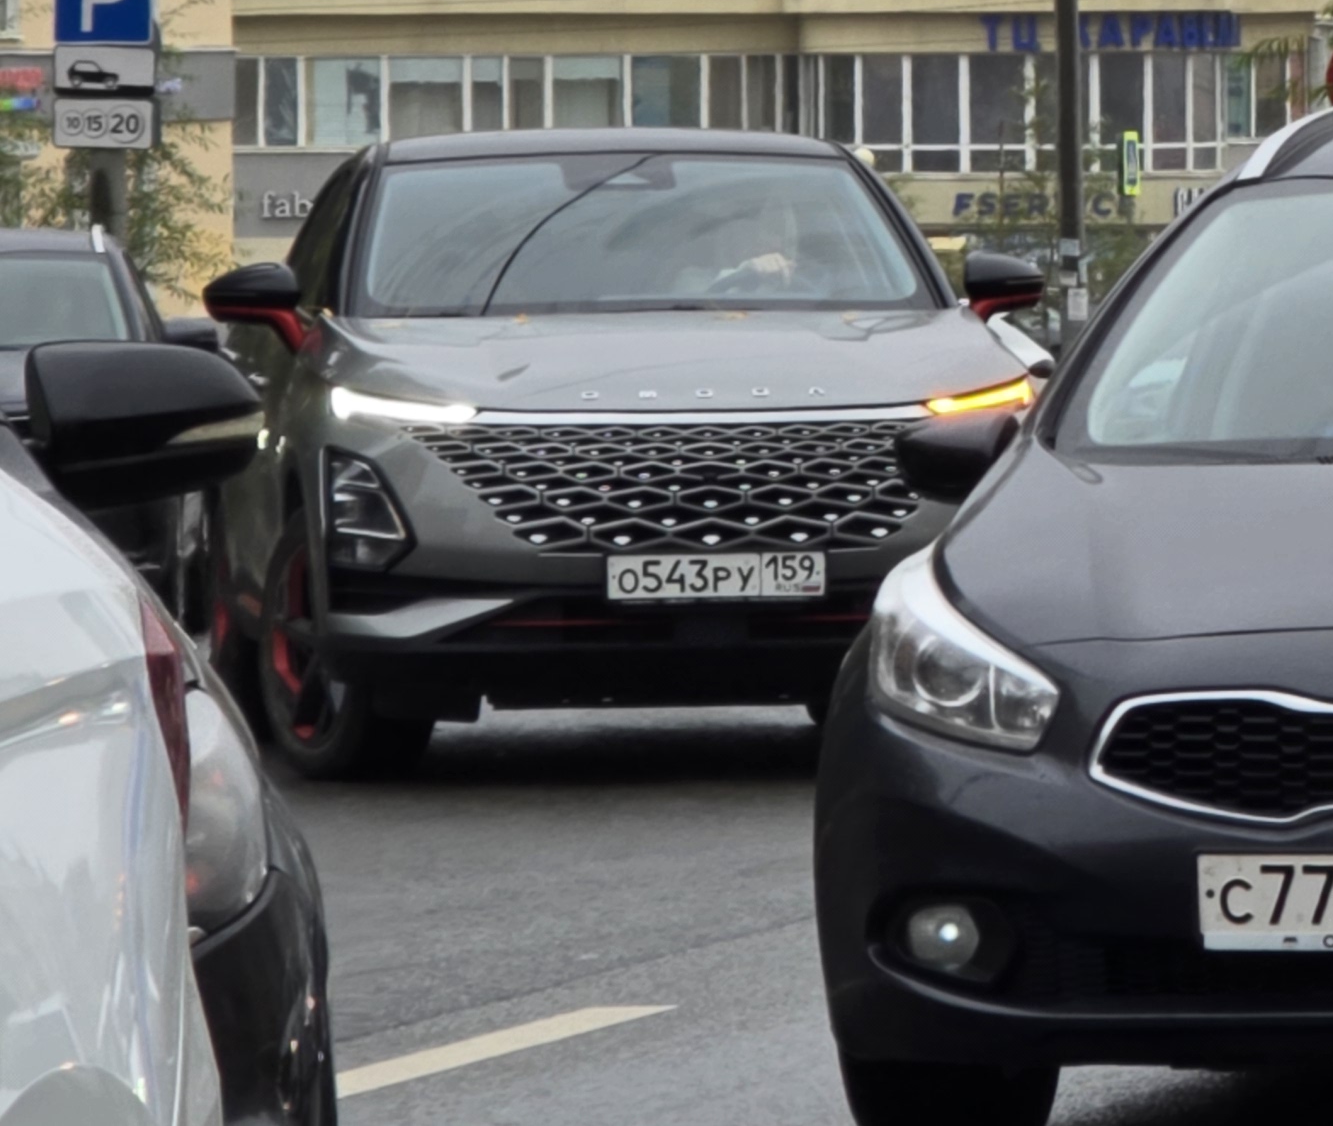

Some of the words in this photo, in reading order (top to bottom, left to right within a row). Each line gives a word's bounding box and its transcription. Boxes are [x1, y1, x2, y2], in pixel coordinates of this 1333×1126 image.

[980, 13, 1041, 52] ТЦ
[66, 116, 80, 129] 10
[86, 115, 103, 132] 15
[110, 113, 140, 134] 20
[764, 554, 815, 582] 159
[775, 584, 800, 592] RUS
